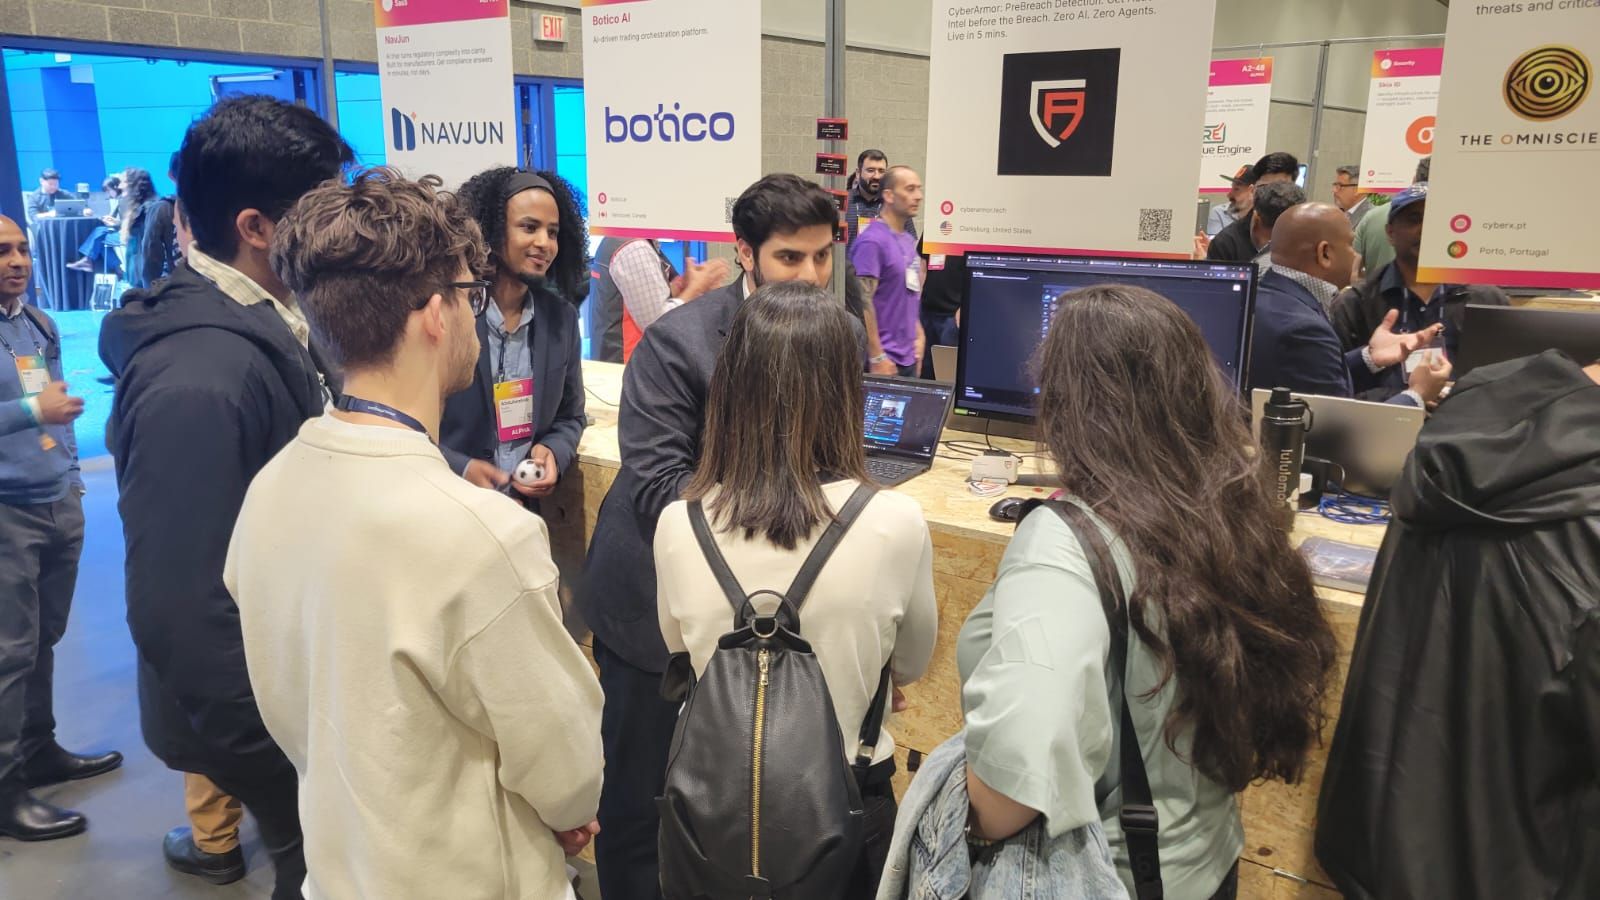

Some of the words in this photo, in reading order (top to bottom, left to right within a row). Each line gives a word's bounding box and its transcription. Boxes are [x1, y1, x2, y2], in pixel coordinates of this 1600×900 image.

[948, 5, 1003, 17] CyberArmor:
[1006, 1, 1052, 11] PreBreach
[1476, 4, 1523, 15] threats
[1527, 0, 1553, 12] and
[592, 15, 620, 26] Botico
[621, 12, 631, 23] AI
[948, 19, 966, 29] Intel
[968, 17, 997, 28] before
[999, 16, 1014, 25] the
[1016, 13, 1050, 24] Breach.
[1053, 12, 1075, 22] Zero
[1077, 10, 1090, 20] AI.
[1093, 9, 1116, 19] Zero
[1118, 6, 1157, 18] Agents.
[543, 16, 563, 39] EXIT
[384, 35, 409, 45] NavJun
[619, 33, 640, 42] trading
[640, 29, 680, 41] orchestration
[947, 31, 964, 41] Live
[966, 30, 974, 40] in
[977, 30, 982, 39] 5
[984, 29, 1008, 39] mins.
[605, 102, 735, 143] botico
[421, 121, 504, 144] NAVJUN
[1460, 134, 1493, 146] THE
[1500, 132, 1598, 145] OMNISCIE
[1217, 145, 1252, 156] Engine
[992, 226, 1012, 234] United
[1012, 227, 1032, 235] States
[1482, 221, 1527, 231] cyberx.pt
[1479, 246, 1507, 256] Porto,
[1509, 247, 1550, 258] Portugal
